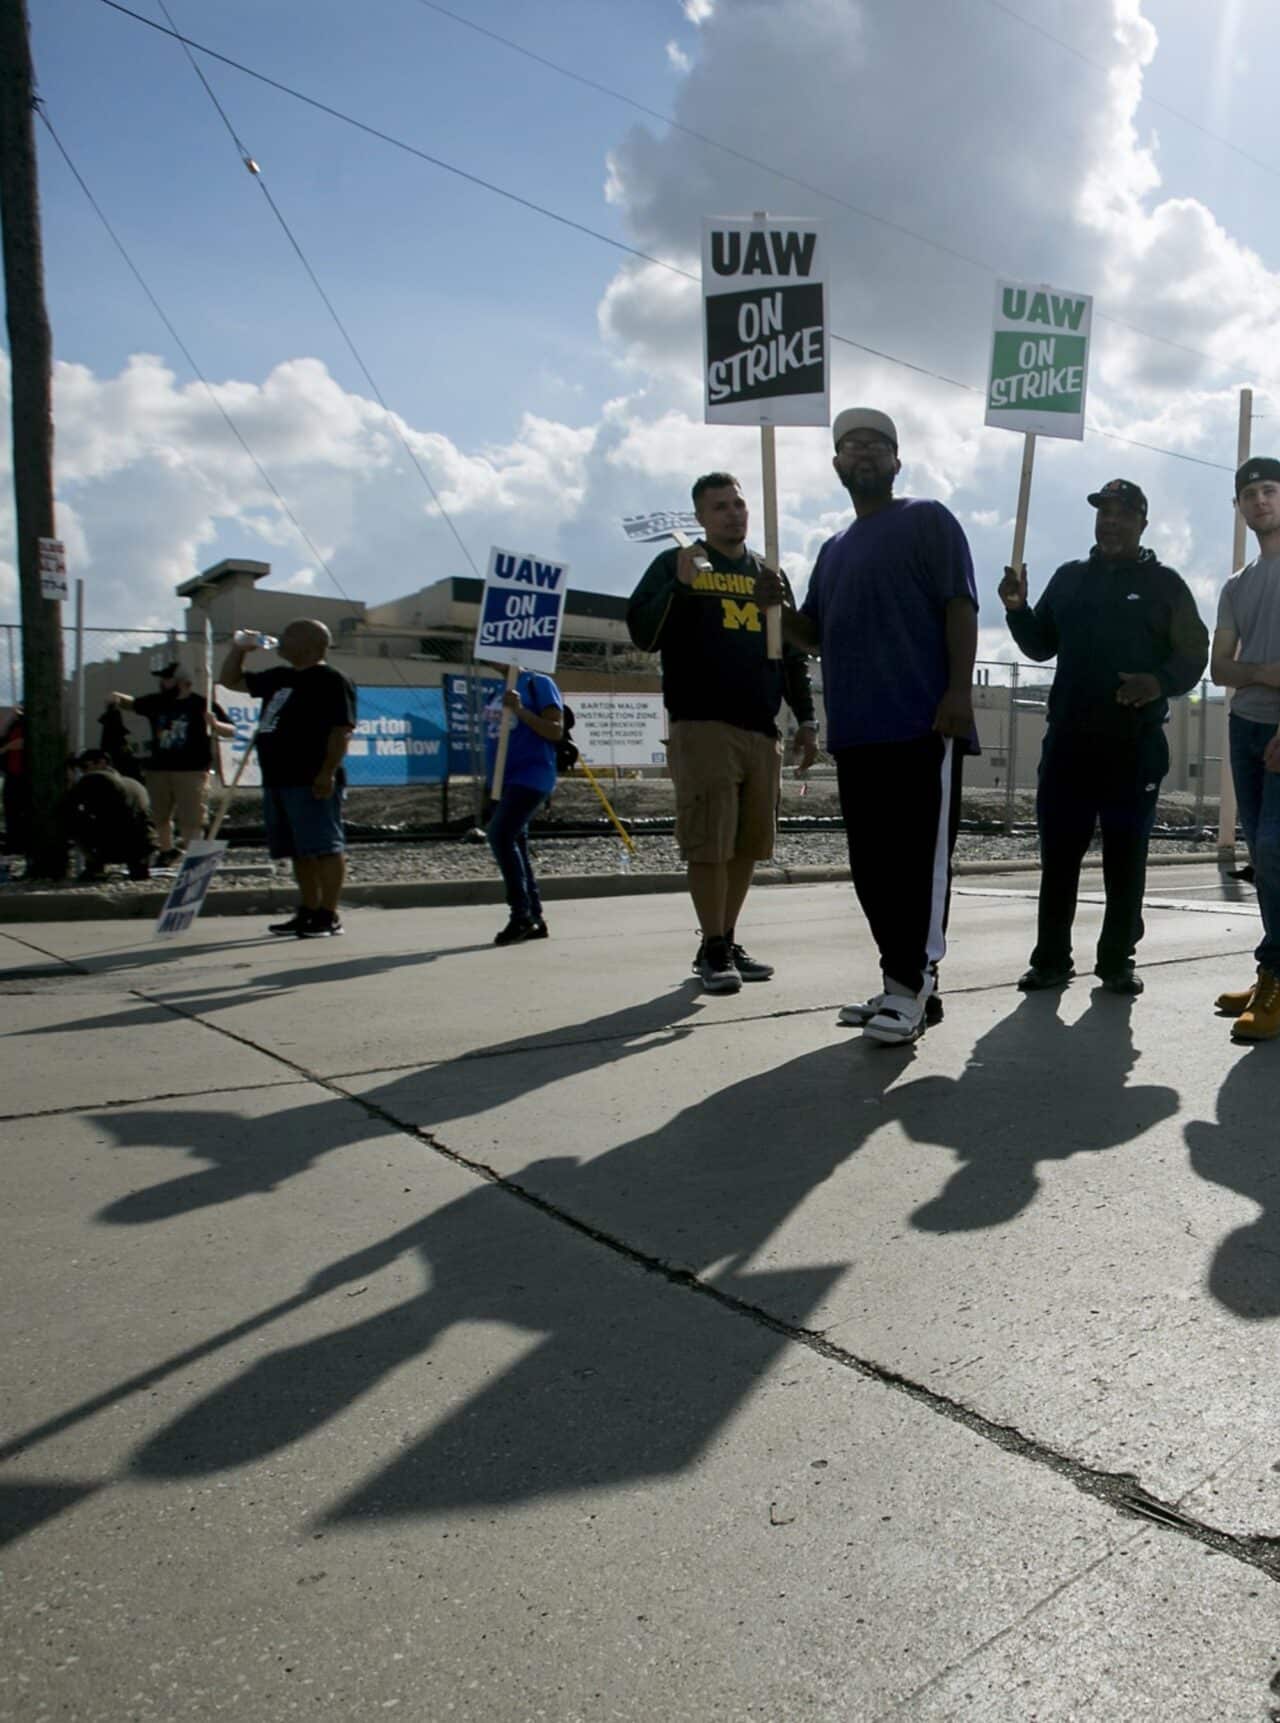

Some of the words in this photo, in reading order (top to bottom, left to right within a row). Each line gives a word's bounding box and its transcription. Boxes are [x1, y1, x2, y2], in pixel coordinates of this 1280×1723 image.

[711, 231, 817, 277] UAW
[738, 292, 783, 343] ON
[1002, 287, 1086, 331] UAW
[708, 326, 823, 401] STRIKE
[1018, 337, 1056, 369] ON
[991, 366, 1083, 407] STRIKE
[495, 553, 562, 590] UAW
[691, 572, 756, 594] MICHIG
[505, 593, 537, 617] ON
[720, 598, 762, 632] M
[481, 616, 558, 644] STRIKE
[376, 738, 441, 756] Malow
